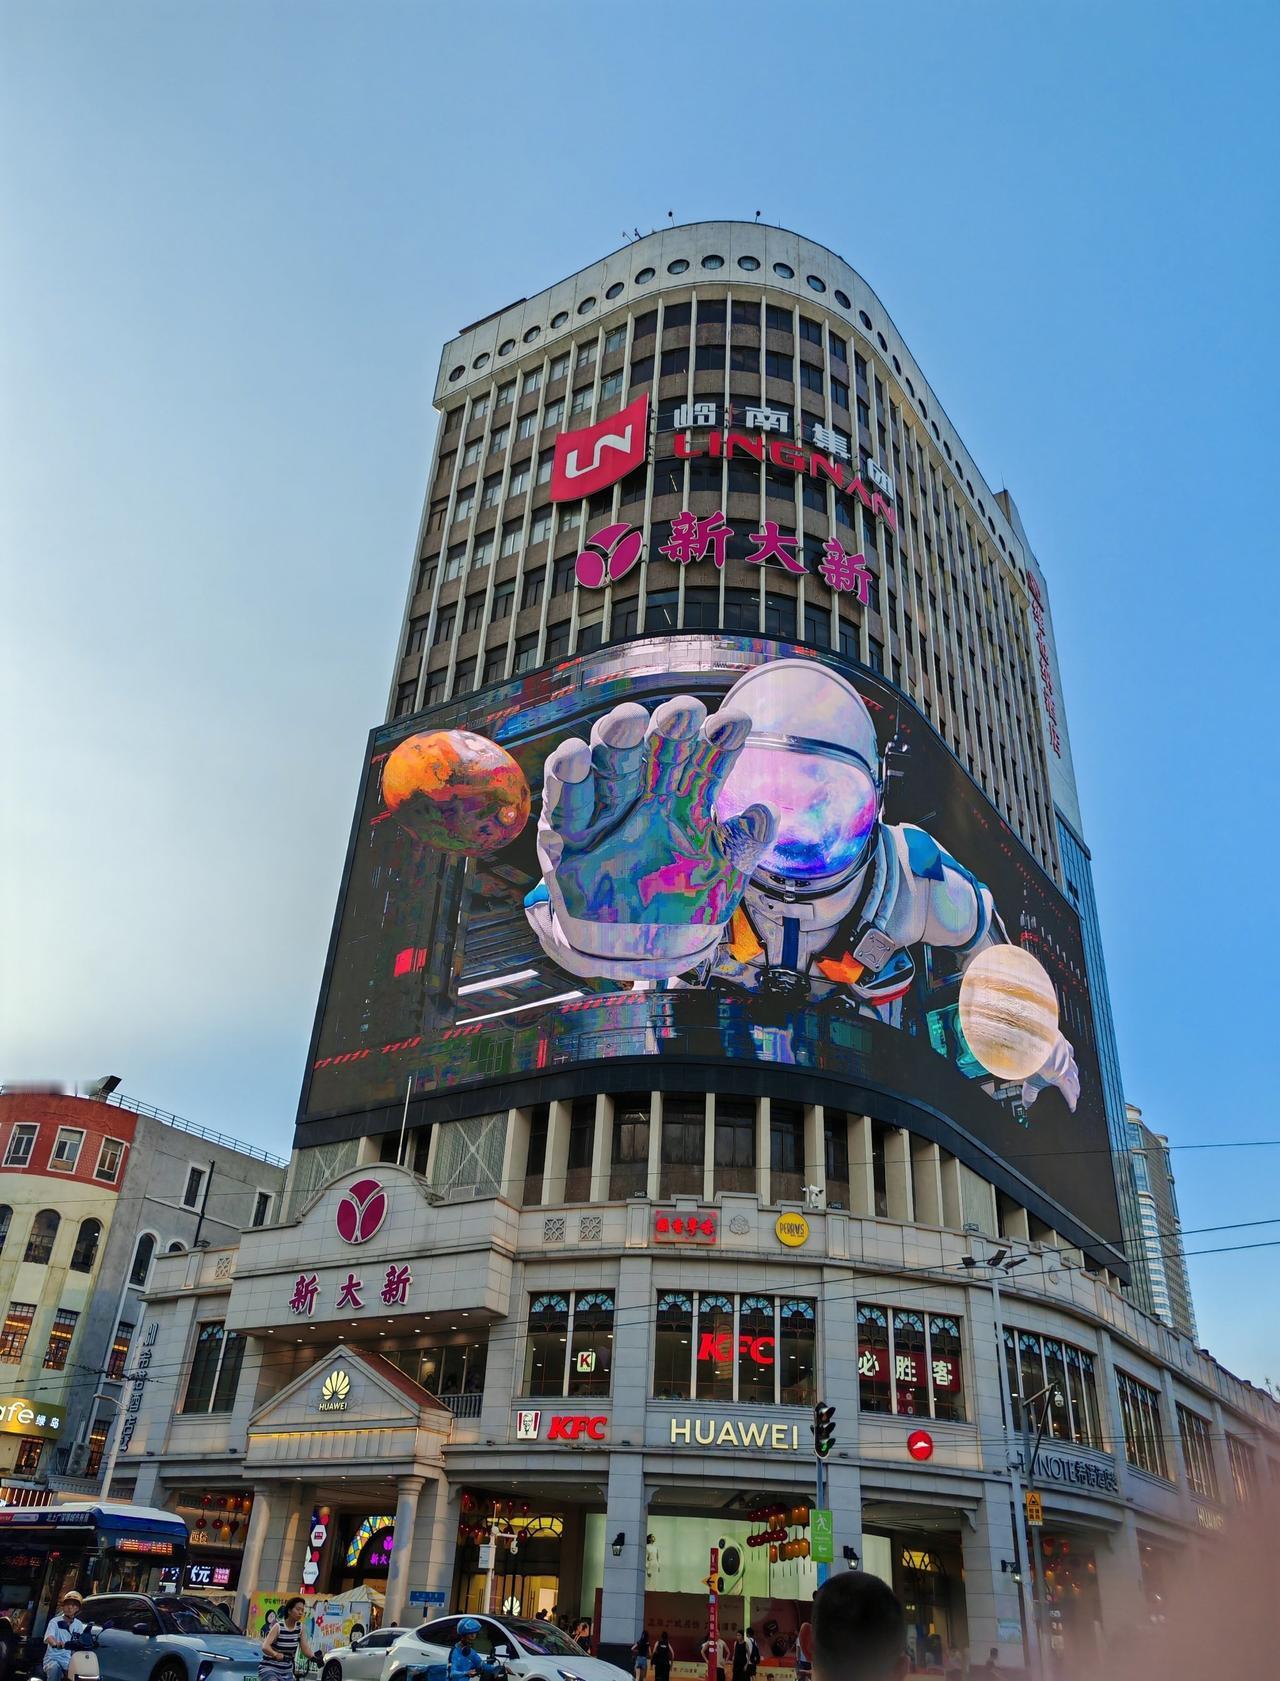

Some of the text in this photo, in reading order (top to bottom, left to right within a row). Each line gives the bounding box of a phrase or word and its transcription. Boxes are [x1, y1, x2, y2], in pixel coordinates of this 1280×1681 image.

[673, 402, 894, 500] 岭南集团
[673, 431, 897, 533] LINGNAN
[658, 510, 874, 607] 新大新
[287, 1263, 414, 1318] 新大新
[697, 1333, 776, 1365] KFC
[858, 1350, 953, 1386] 必胜客
[318, 1402, 348, 1412] HUAWEI
[547, 1415, 608, 1440] KFC
[670, 1418, 799, 1450] HUAWEI
[370, 1551, 391, 1566] 新大
